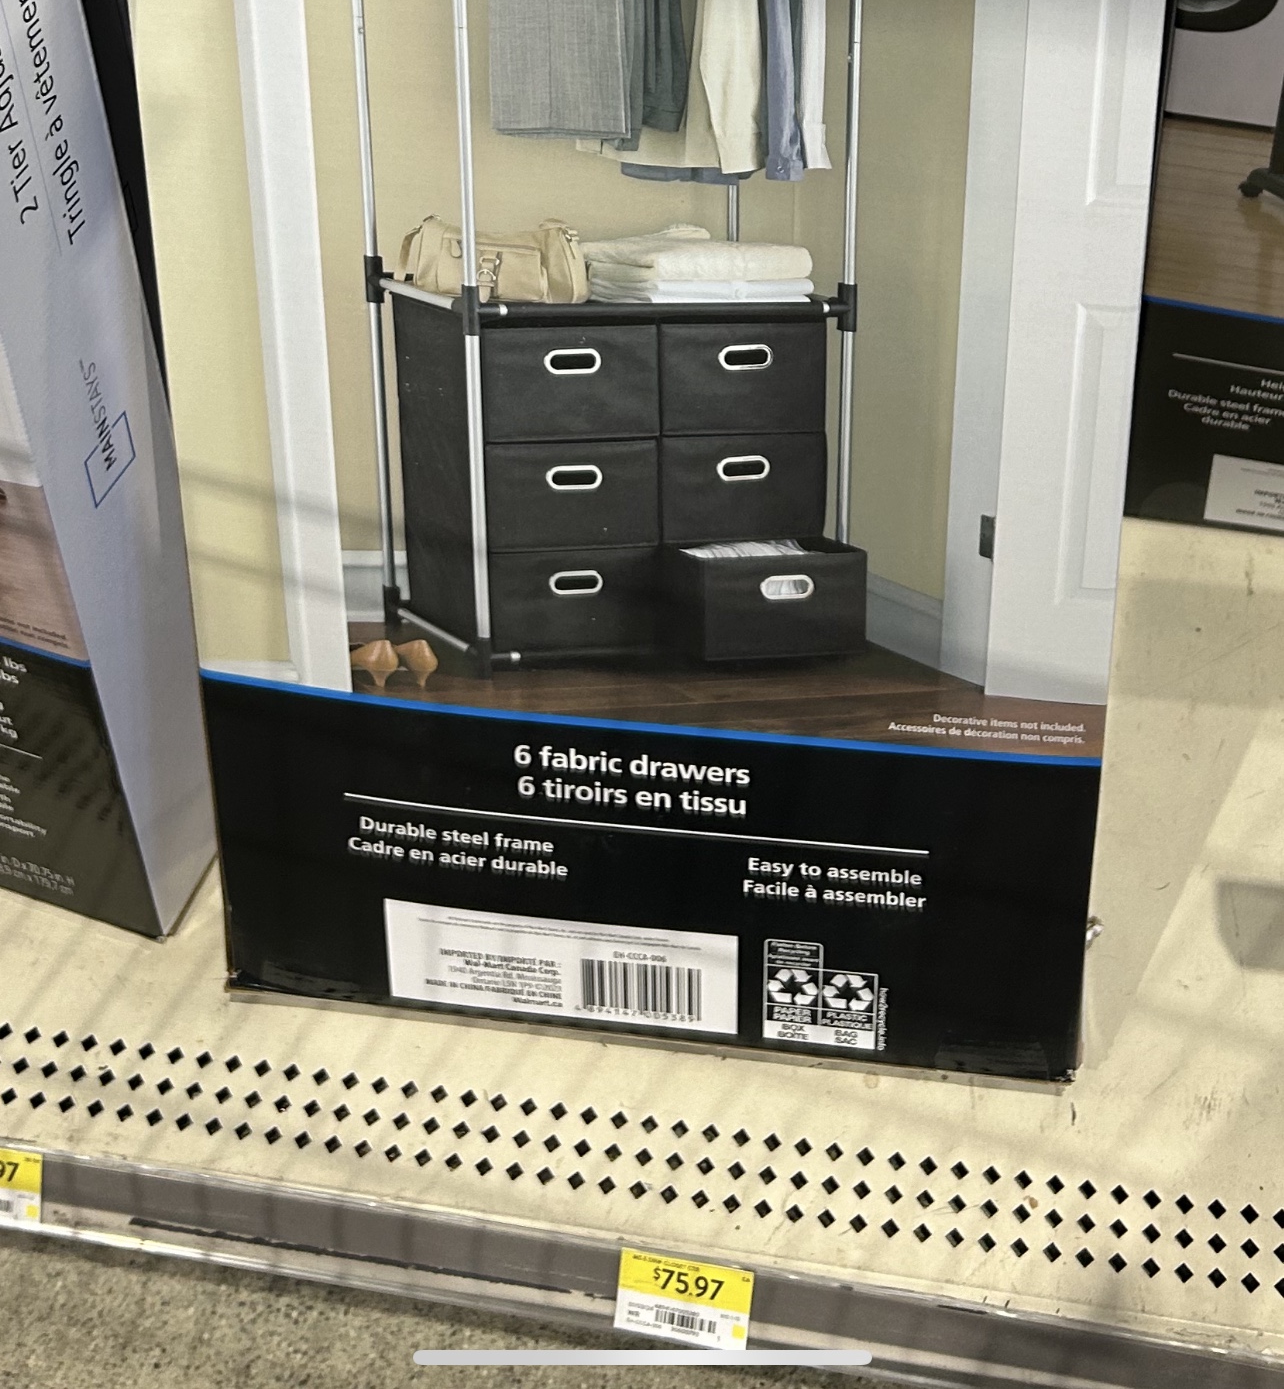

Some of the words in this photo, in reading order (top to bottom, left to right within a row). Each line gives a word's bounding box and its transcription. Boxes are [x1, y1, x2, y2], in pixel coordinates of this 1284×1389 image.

[45, 114, 64, 141] à
[8, 140, 32, 203] Tier
[52, 139, 86, 245] Tringle
[20, 196, 38, 224] 2
[1168, 389, 1218, 405] Durable
[82, 362, 117, 471] MAINSTAYS
[888, 722, 947, 735] Accessoires
[948, 726, 962, 736] de
[963, 727, 1018, 740] décoration
[1020, 732, 1041, 741] non
[1042, 733, 1086, 745] compris.
[933, 713, 988, 727] Decorative
[990, 718, 1018, 729] items
[1020, 721, 1038, 730] not
[1040, 721, 1086, 733] included.
[514, 744, 532, 765] 6
[538, 745, 623, 774] fabric
[629, 754, 750, 785] drawers
[517, 775, 535, 796] 6
[542, 777, 628, 804] tiroirs
[635, 790, 672, 809] en
[679, 790, 747, 815] tissu
[359, 816, 437, 840] Durable
[442, 829, 489, 846] steel
[494, 833, 554, 852] frame
[348, 836, 405, 857] Cadre
[409, 848, 434, 861] en
[438, 851, 487, 867] acier
[491, 855, 568, 876] durable
[747, 857, 794, 877] Easy
[799, 862, 822, 876] to
[826, 866, 922, 885] assemble
[742, 879, 800, 897] Facile
[804, 884, 817, 899] à
[822, 889, 927, 908] assembler
[773, 1006, 811, 1017] PAPER
[826, 1011, 868, 1022] PLASTIC
[834, 1030, 858, 1038] BAG
[834, 1037, 857, 1045] SAC
[653, 1266, 725, 1301] $75.97
